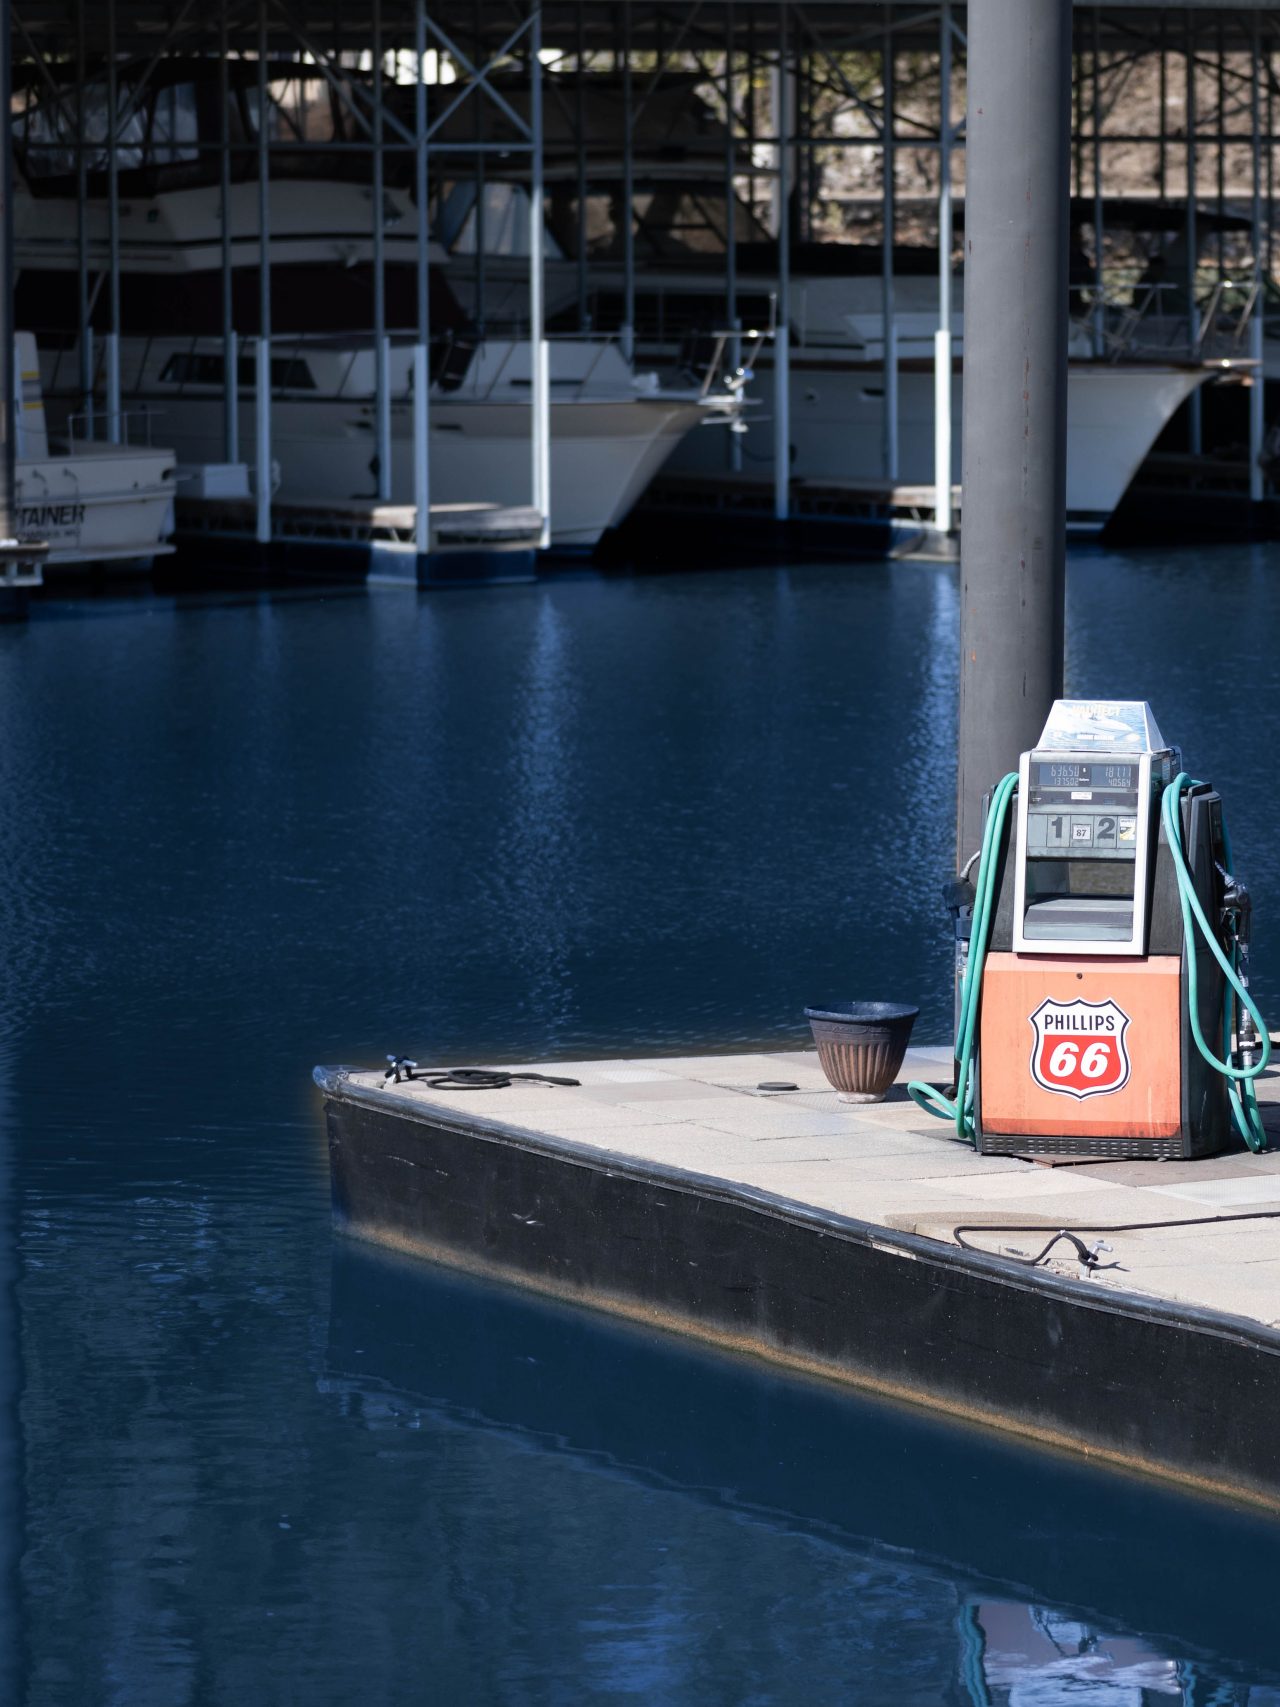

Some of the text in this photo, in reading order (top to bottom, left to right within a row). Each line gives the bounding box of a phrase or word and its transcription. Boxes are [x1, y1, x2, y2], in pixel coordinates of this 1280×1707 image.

[16, 504, 86, 527] TAINER
[1051, 816, 1063, 838] 1
[1076, 829, 1087, 837] 87
[1097, 817, 1115, 839] 2
[1044, 1014, 1115, 1031] PHILLIPS
[1049, 1041, 1111, 1078] 66
